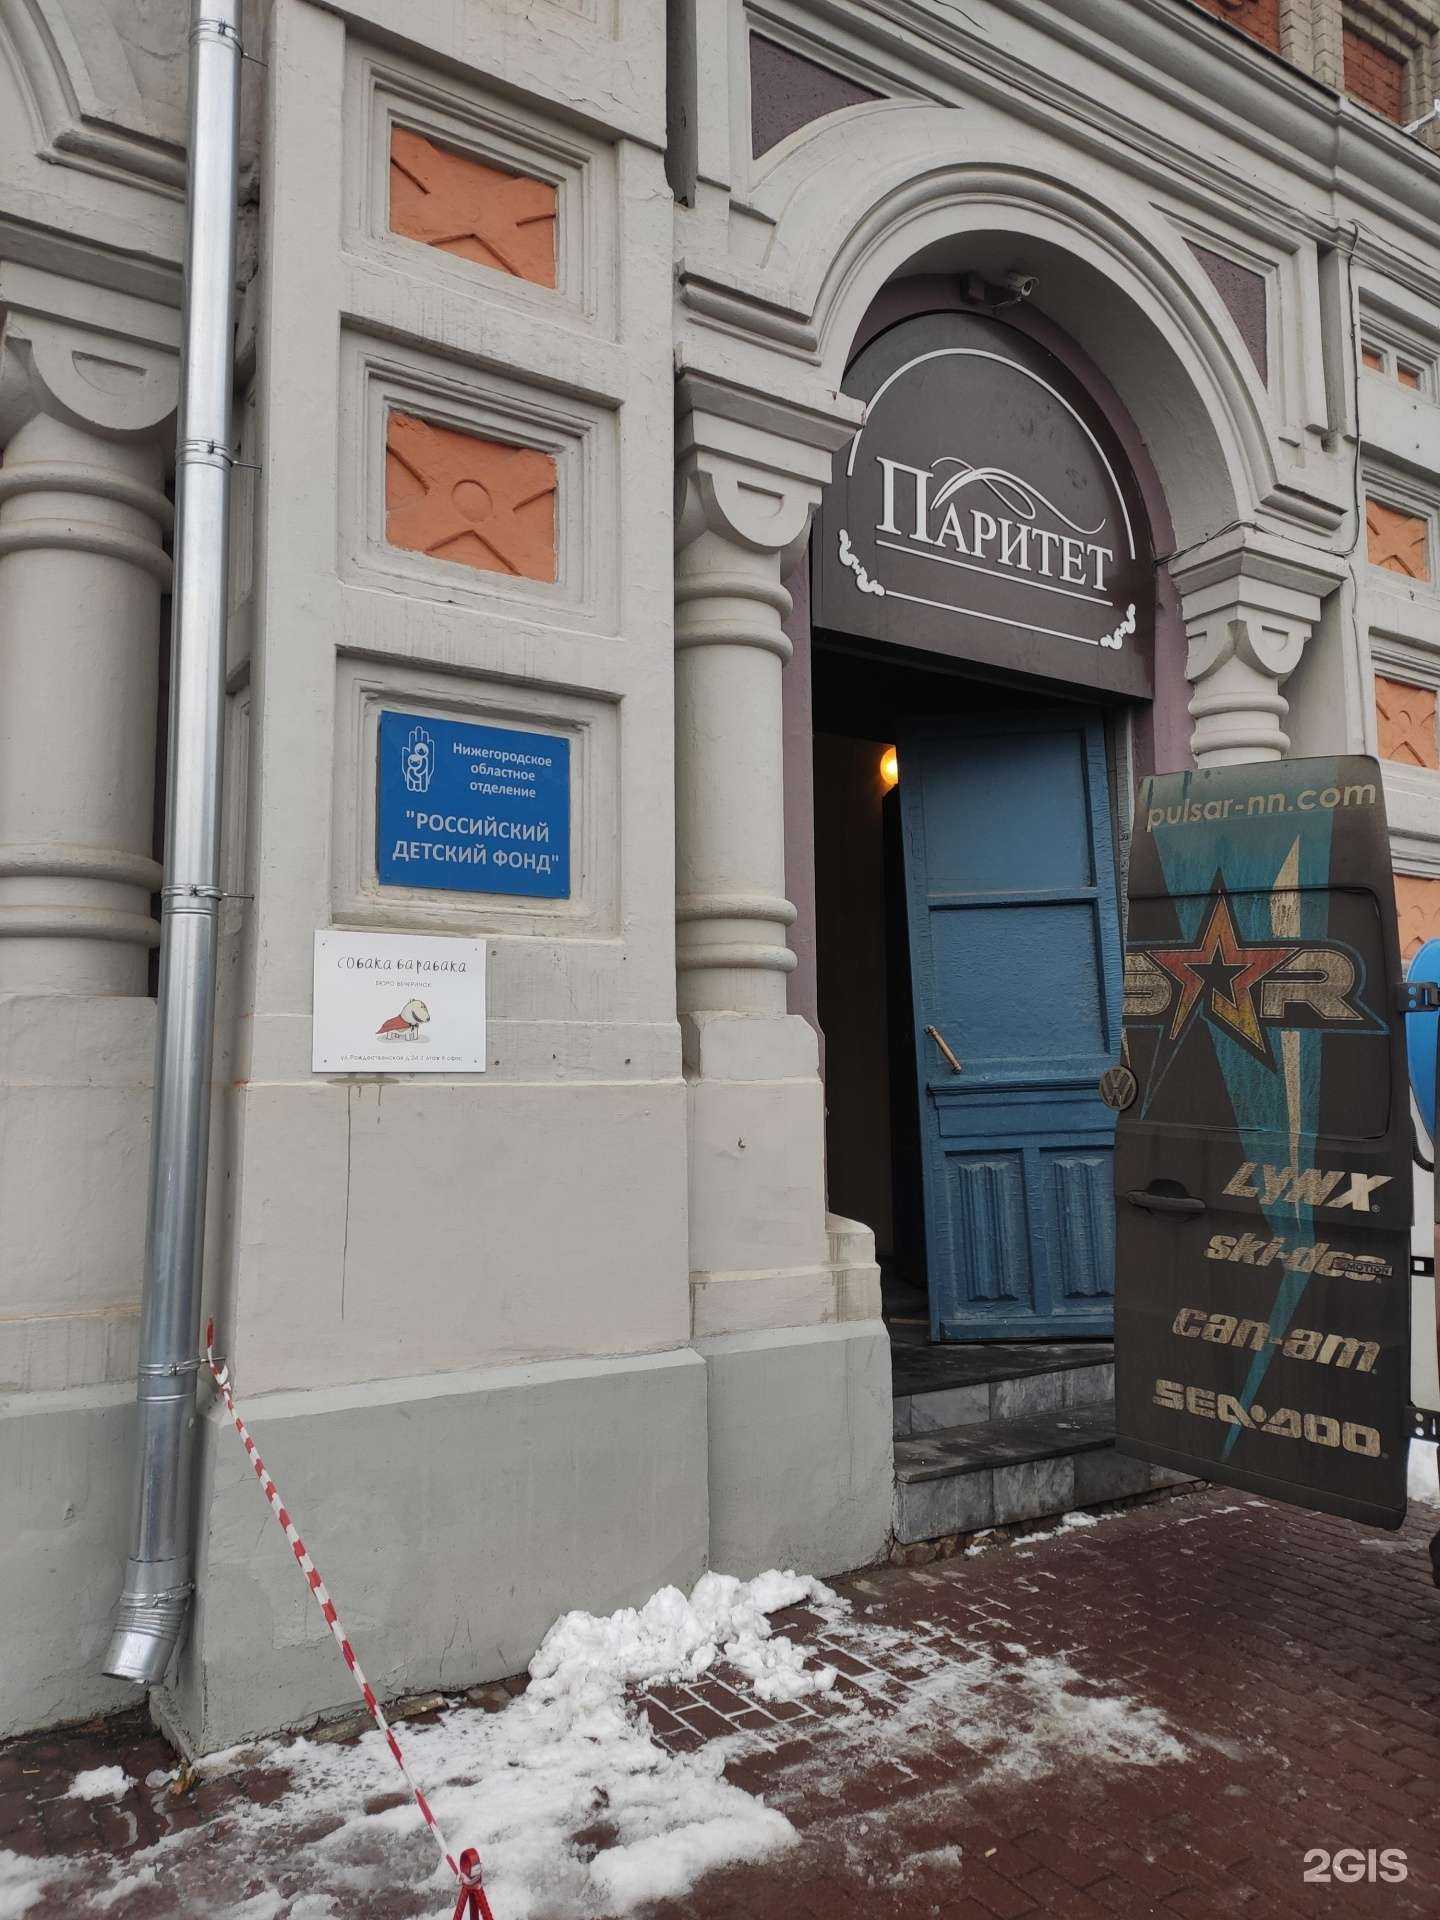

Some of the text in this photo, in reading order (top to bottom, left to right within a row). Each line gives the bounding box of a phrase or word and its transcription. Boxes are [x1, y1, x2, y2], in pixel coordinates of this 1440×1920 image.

[453, 743, 552, 767] Нижегородское
[470, 763, 535, 782] областное
[470, 781, 536, 798] отделение
[1147, 781, 1376, 832] pulsar-nn.com
[406, 811, 549, 842] "РОССИЙСКИЙ
[392, 840, 559, 875] ДЕТСКИЙ ФОНД"
